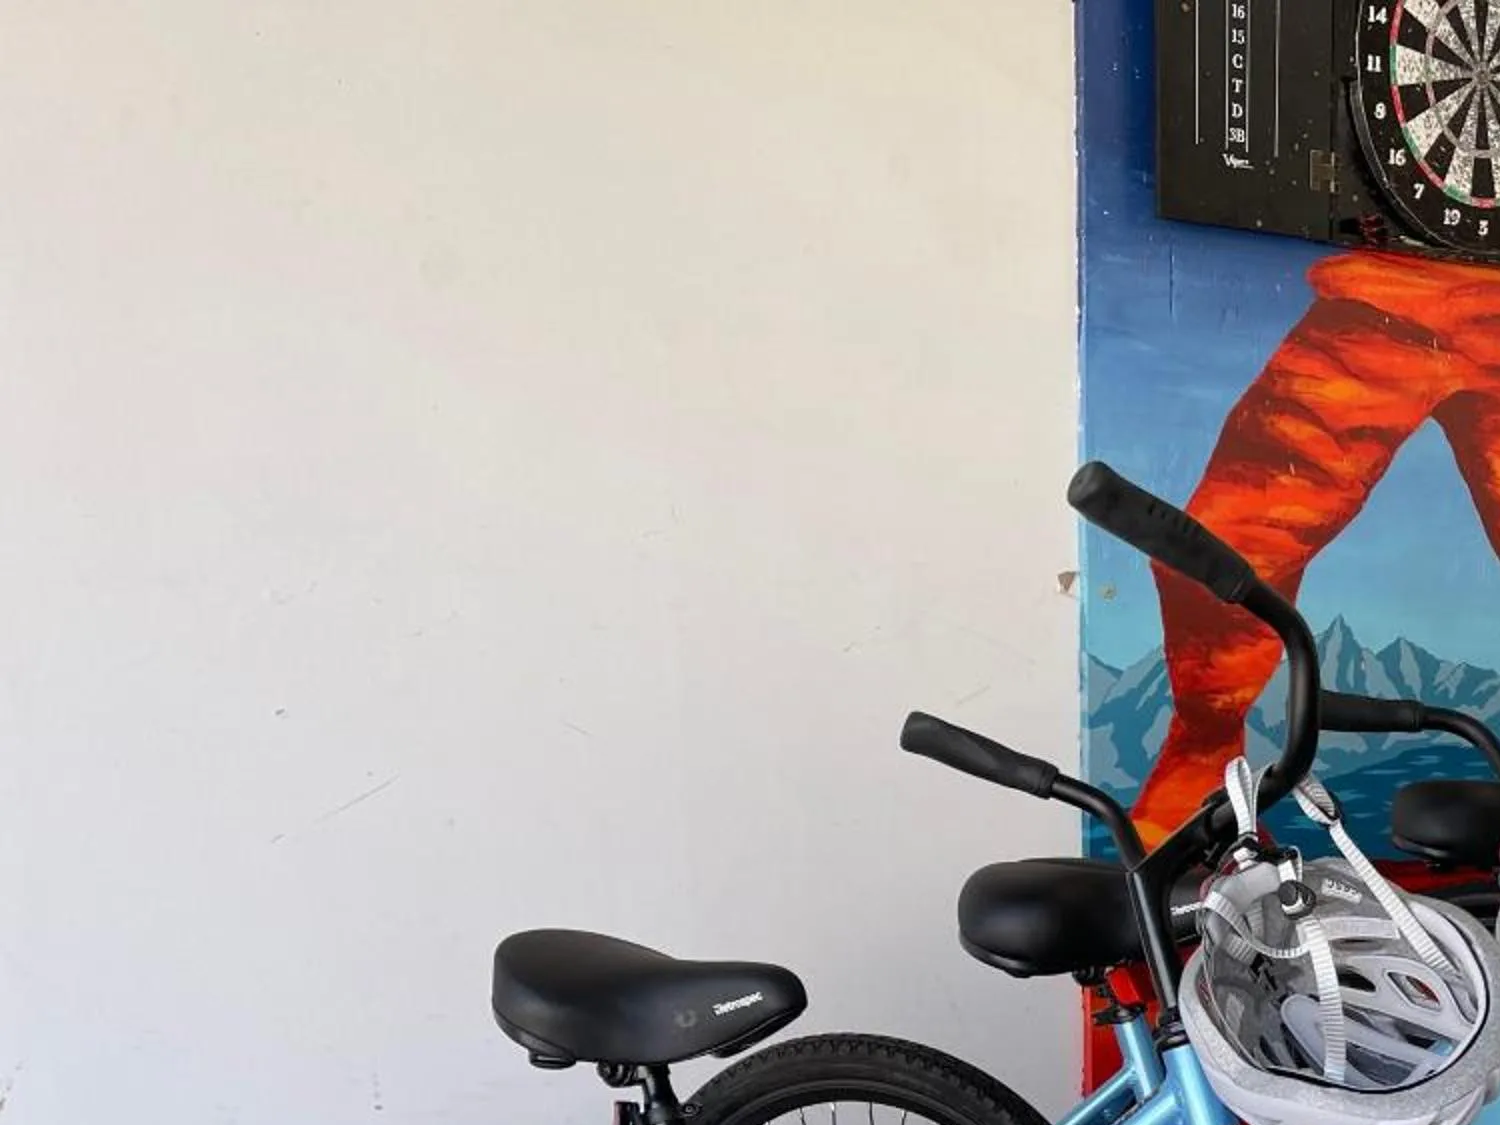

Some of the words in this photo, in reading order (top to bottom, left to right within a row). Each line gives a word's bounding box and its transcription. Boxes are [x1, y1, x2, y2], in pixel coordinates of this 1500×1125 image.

[1231, 3, 1245, 19] 16
[1367, 5, 1387, 24] 14
[1231, 28, 1245, 45] 15
[1232, 53, 1243, 69] C
[1366, 53, 1381, 73] 11
[1231, 78, 1243, 94] T
[1231, 101, 1243, 119] D
[1374, 102, 1387, 120] 8
[1387, 147, 1407, 167] 16
[1413, 182, 1425, 200] 7
[1442, 207, 1462, 227] 19
[1477, 219, 1489, 236] 3
